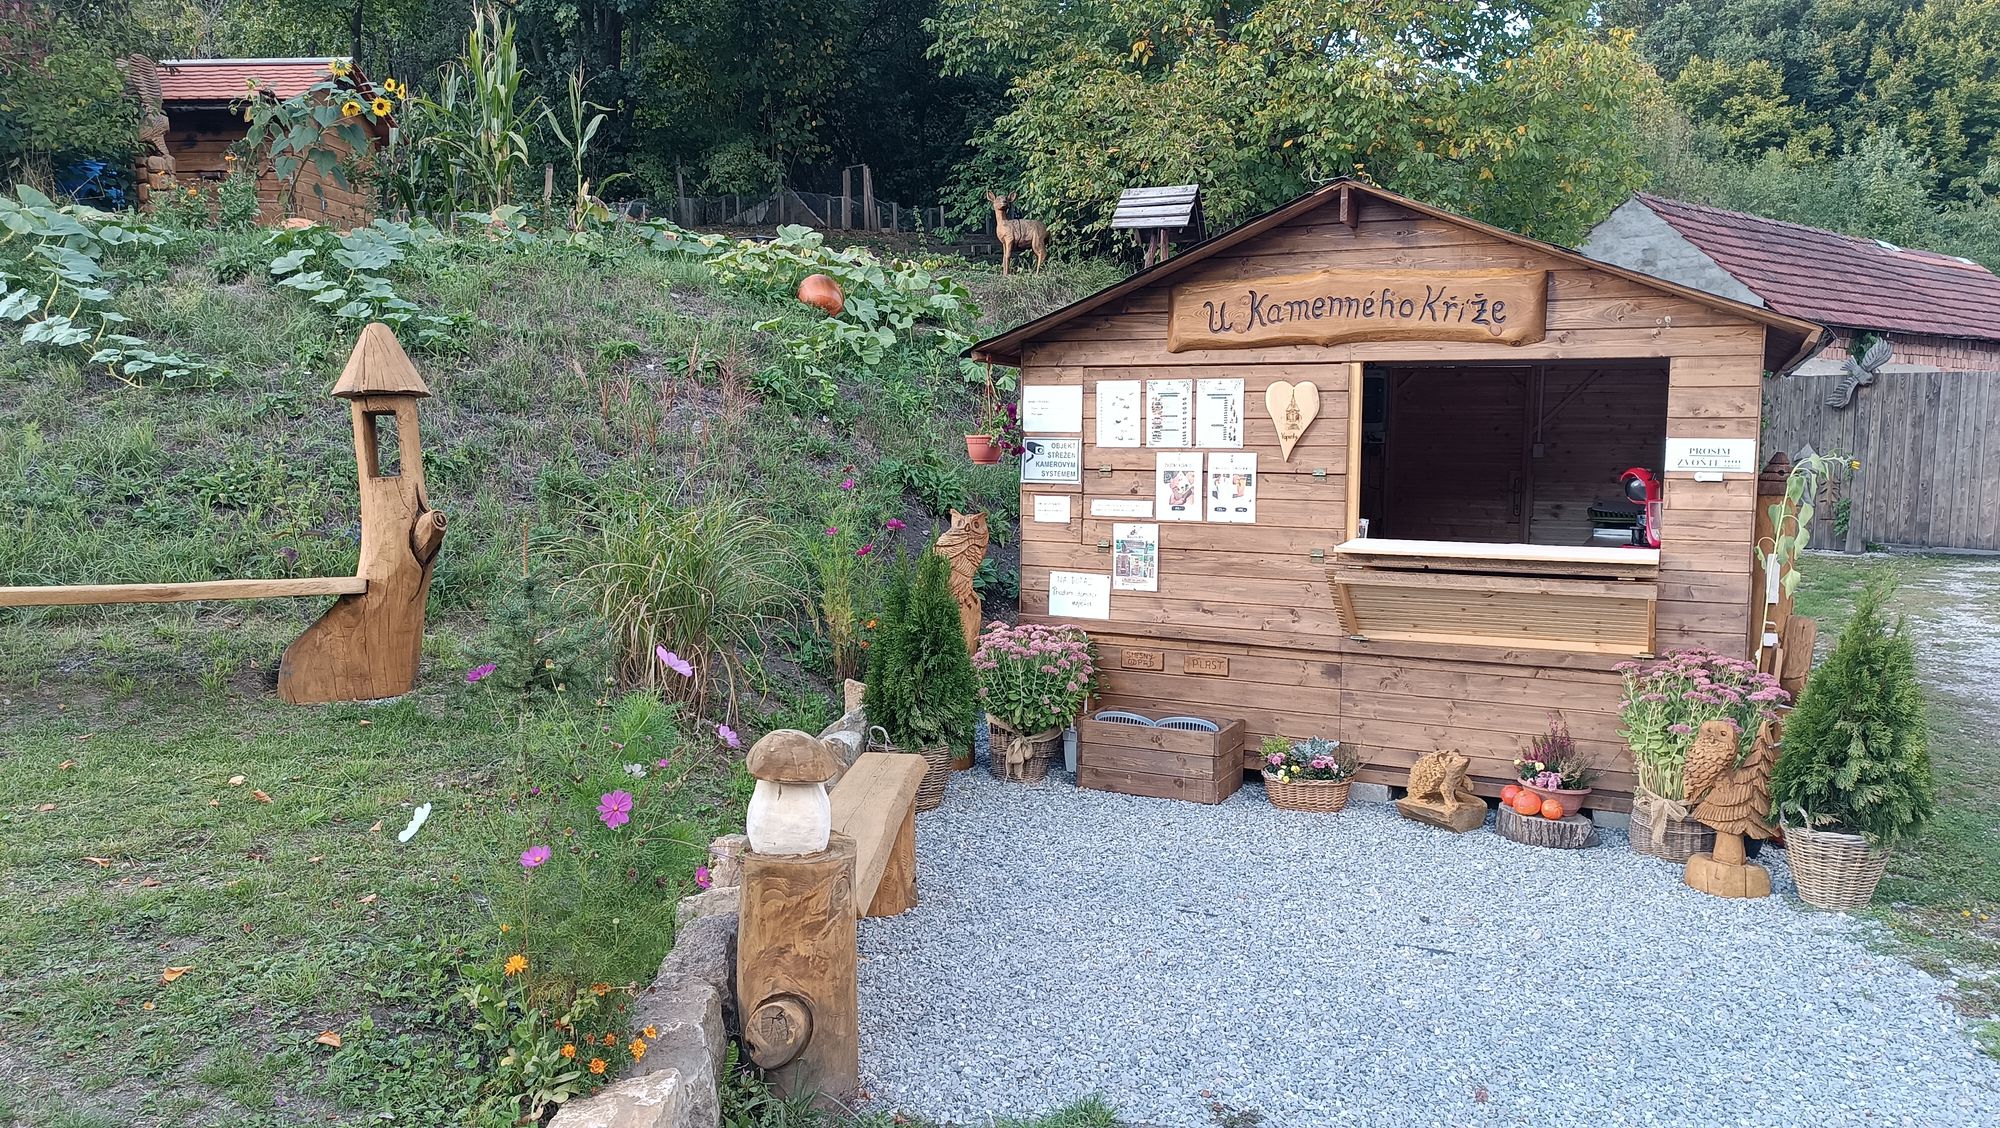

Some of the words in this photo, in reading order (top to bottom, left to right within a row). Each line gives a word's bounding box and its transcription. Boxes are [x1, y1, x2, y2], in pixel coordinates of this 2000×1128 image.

[1203, 300, 1233, 334] U
[1247, 287, 1415, 332] Kamenného
[1417, 285, 1507, 326] Kříže
[1192, 658, 1225, 670] PLAST
